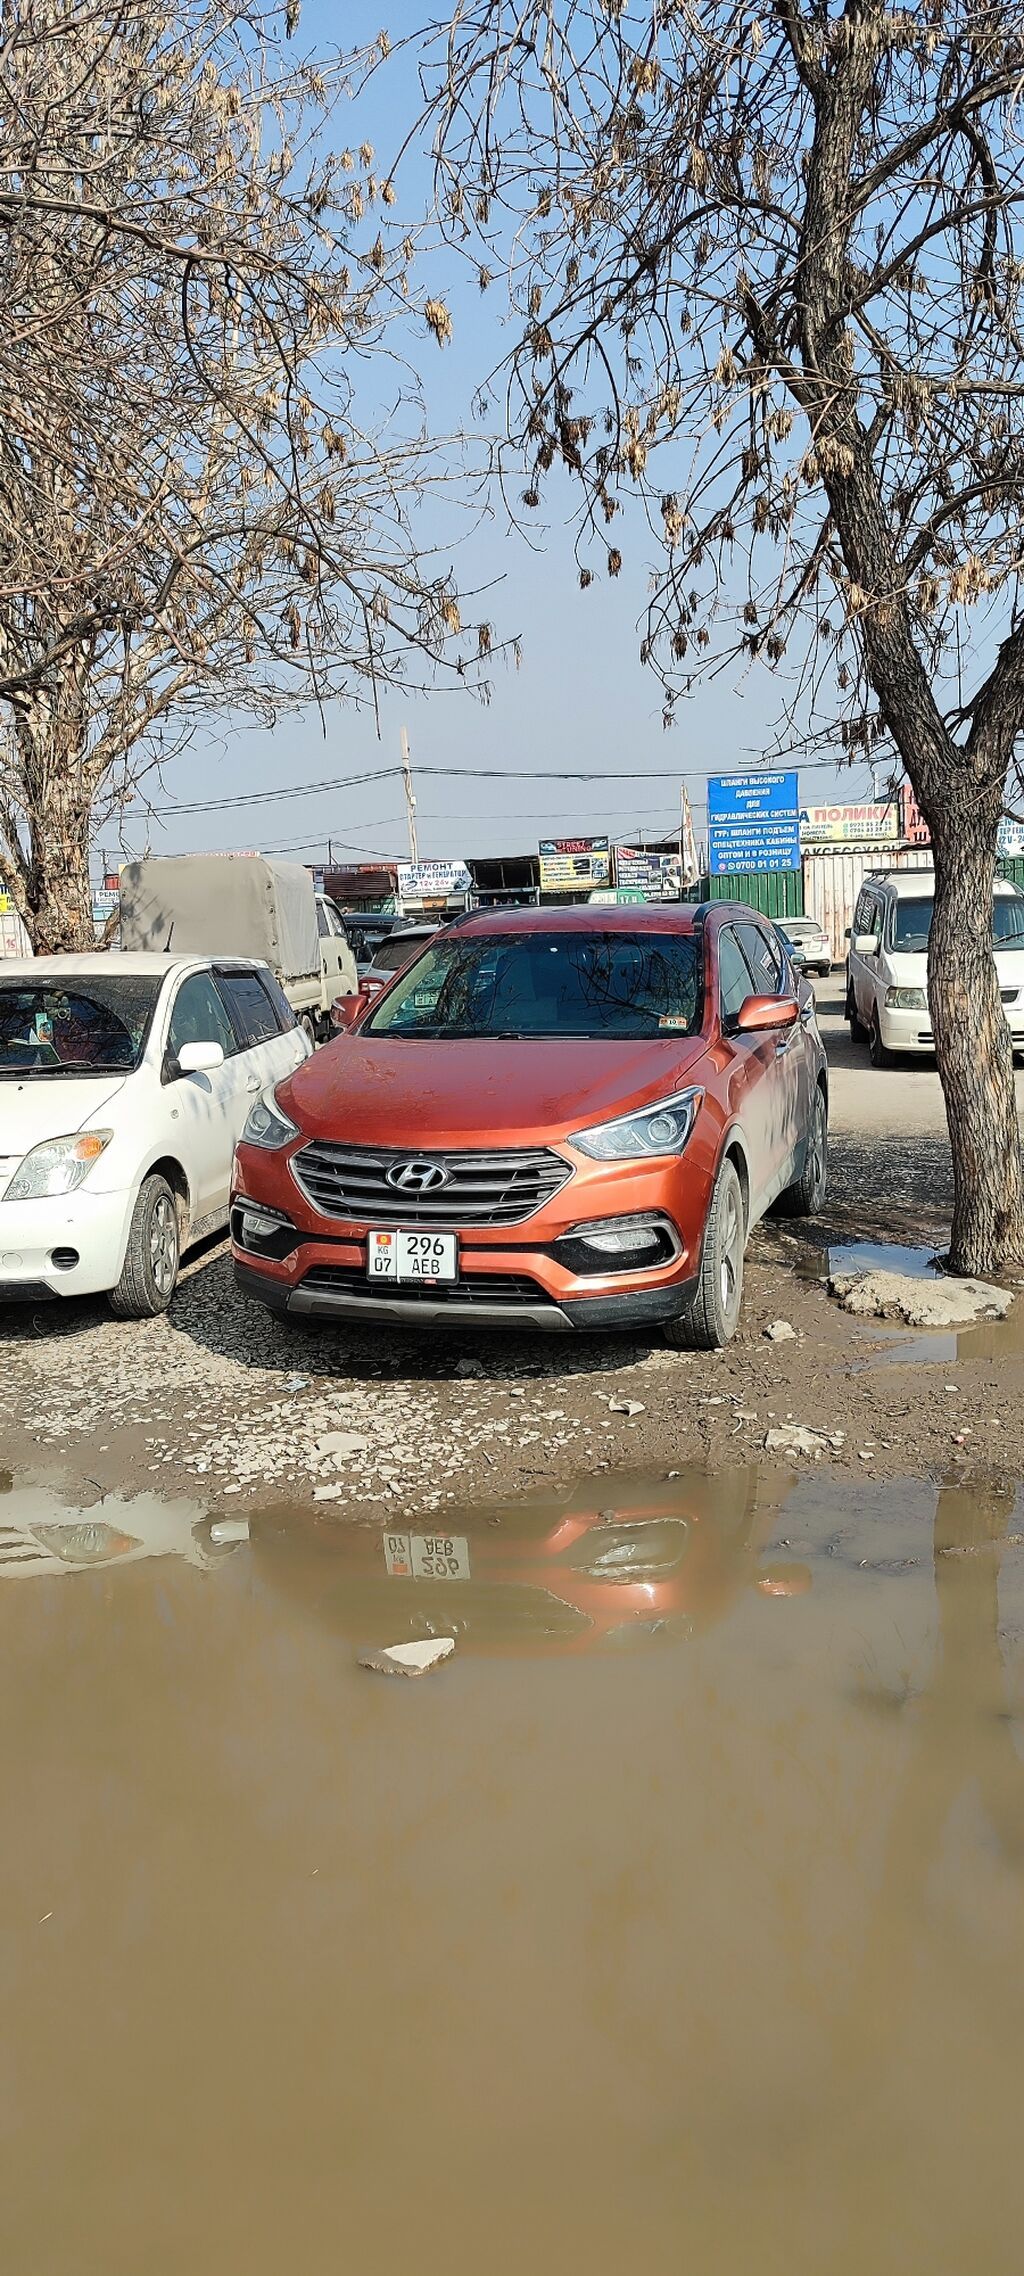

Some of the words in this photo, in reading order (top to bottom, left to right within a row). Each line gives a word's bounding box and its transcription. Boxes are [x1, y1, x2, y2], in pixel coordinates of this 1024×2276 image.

[749, 776, 785, 785] ВЫСОКОГО
[770, 809, 797, 818] СИСТЕМ
[731, 827, 762, 837] ШЛАНГИ
[763, 826, 795, 836] ПОДЪЕМ
[712, 839, 765, 849] СПЕЦТЕХНИКА
[766, 837, 797, 846] КАБИНЫ
[718, 850, 743, 859] ОПТОМ
[759, 848, 792, 857] РОЗНИЦУ
[410, 863, 453, 872] РЕМОНТ
[736, 861, 756, 869] 0700
[757, 860, 766, 868] 01
[769, 859, 779, 868] 01
[781, 858, 792, 867] 25
[378, 1246, 389, 1254] KG
[407, 1237, 444, 1256] 296
[374, 1257, 392, 1272] 07
[411, 1258, 440, 1275] AEB
